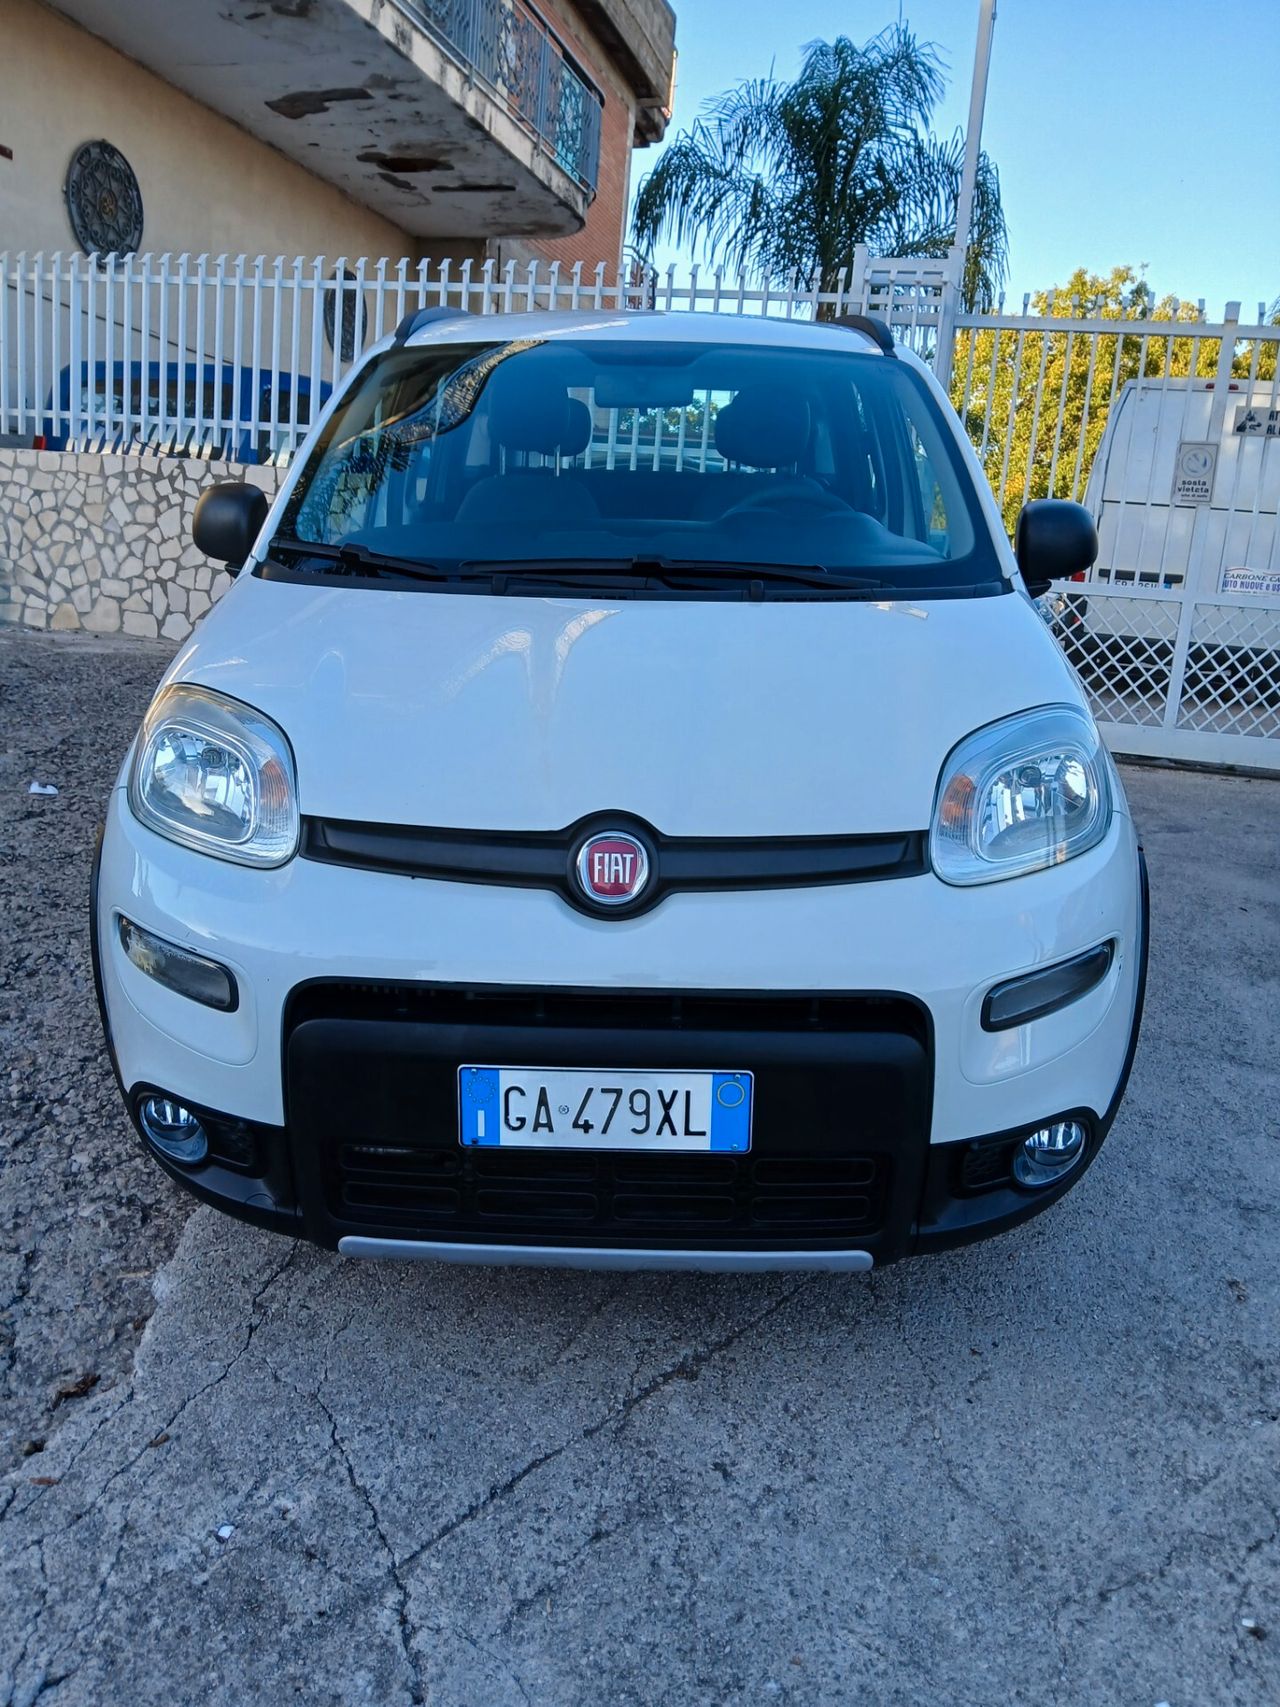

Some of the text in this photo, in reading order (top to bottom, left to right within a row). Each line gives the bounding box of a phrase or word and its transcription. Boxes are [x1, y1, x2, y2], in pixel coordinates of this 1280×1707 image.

[1177, 485, 1209, 493] vietata
[1223, 572, 1268, 582] CARBONE
[1239, 580, 1265, 590] NUOVE
[593, 852, 635, 884] FIAT
[503, 1085, 707, 1137] GA 479XL
